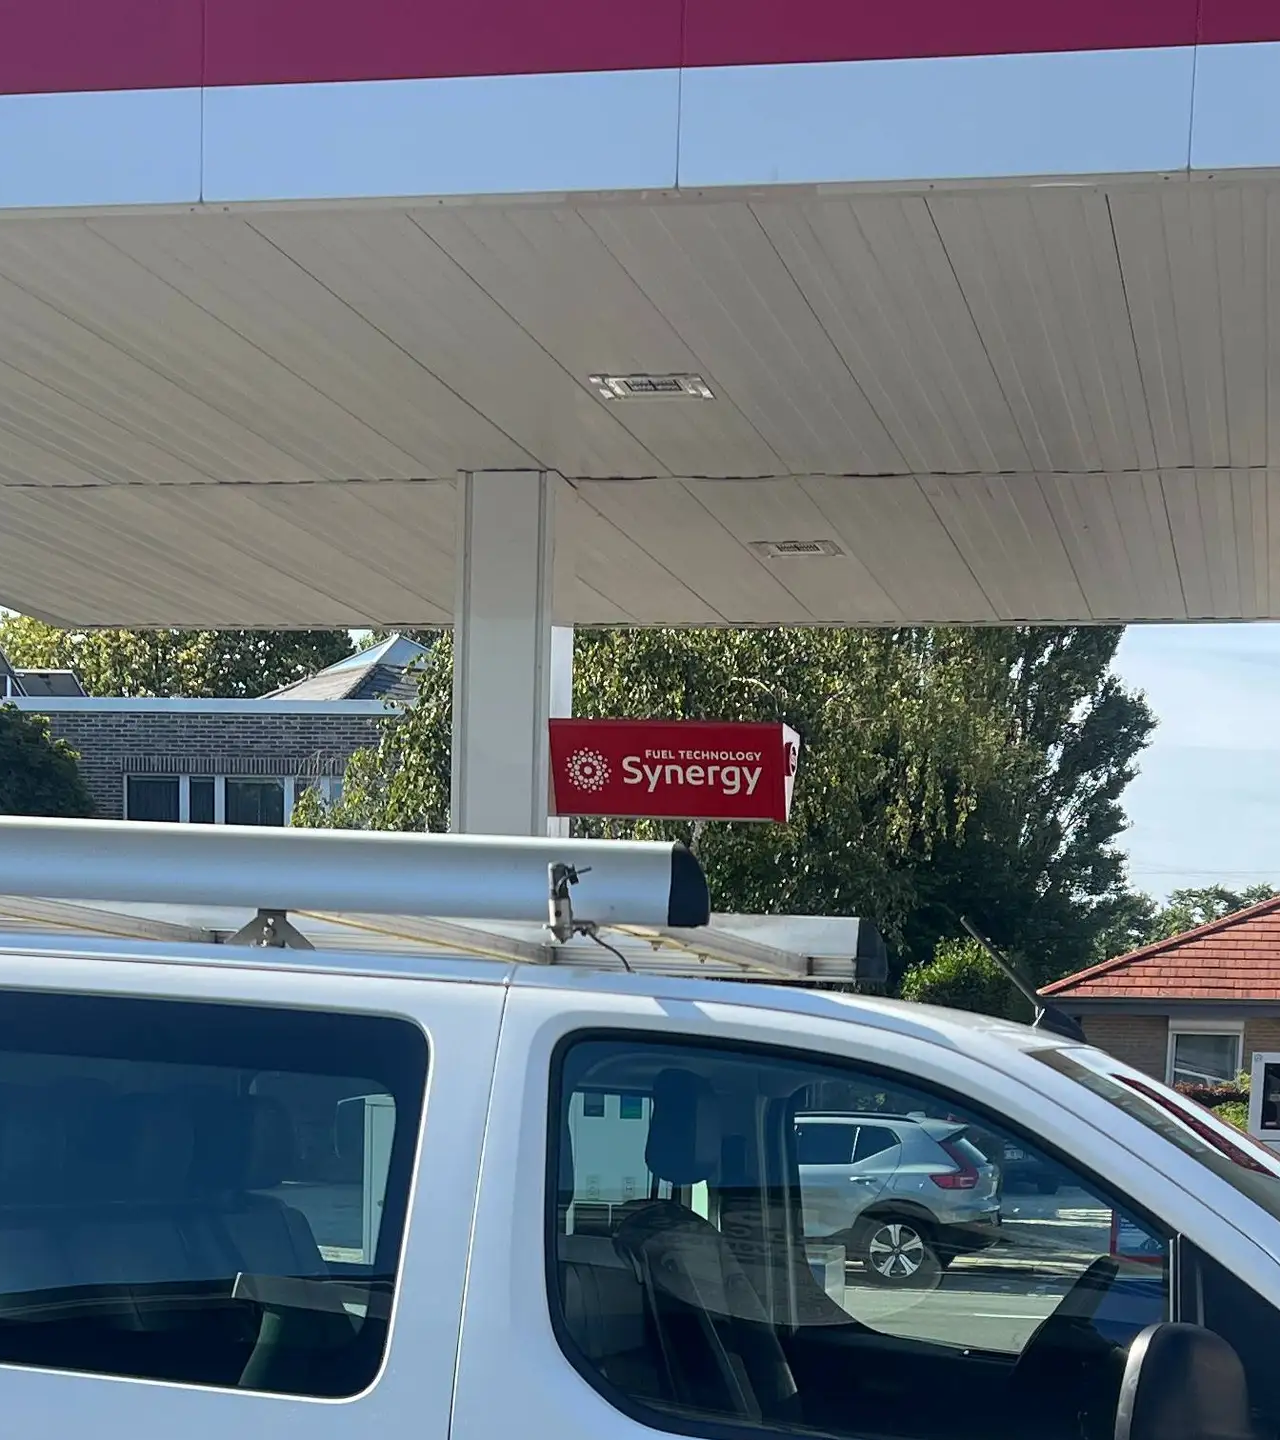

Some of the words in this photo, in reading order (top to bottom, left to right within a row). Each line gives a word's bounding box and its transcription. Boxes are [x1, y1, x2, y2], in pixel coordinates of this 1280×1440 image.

[645, 749, 675, 760] FUEL
[678, 750, 763, 762] TECHNOLOGY
[621, 755, 763, 796] Synergy
